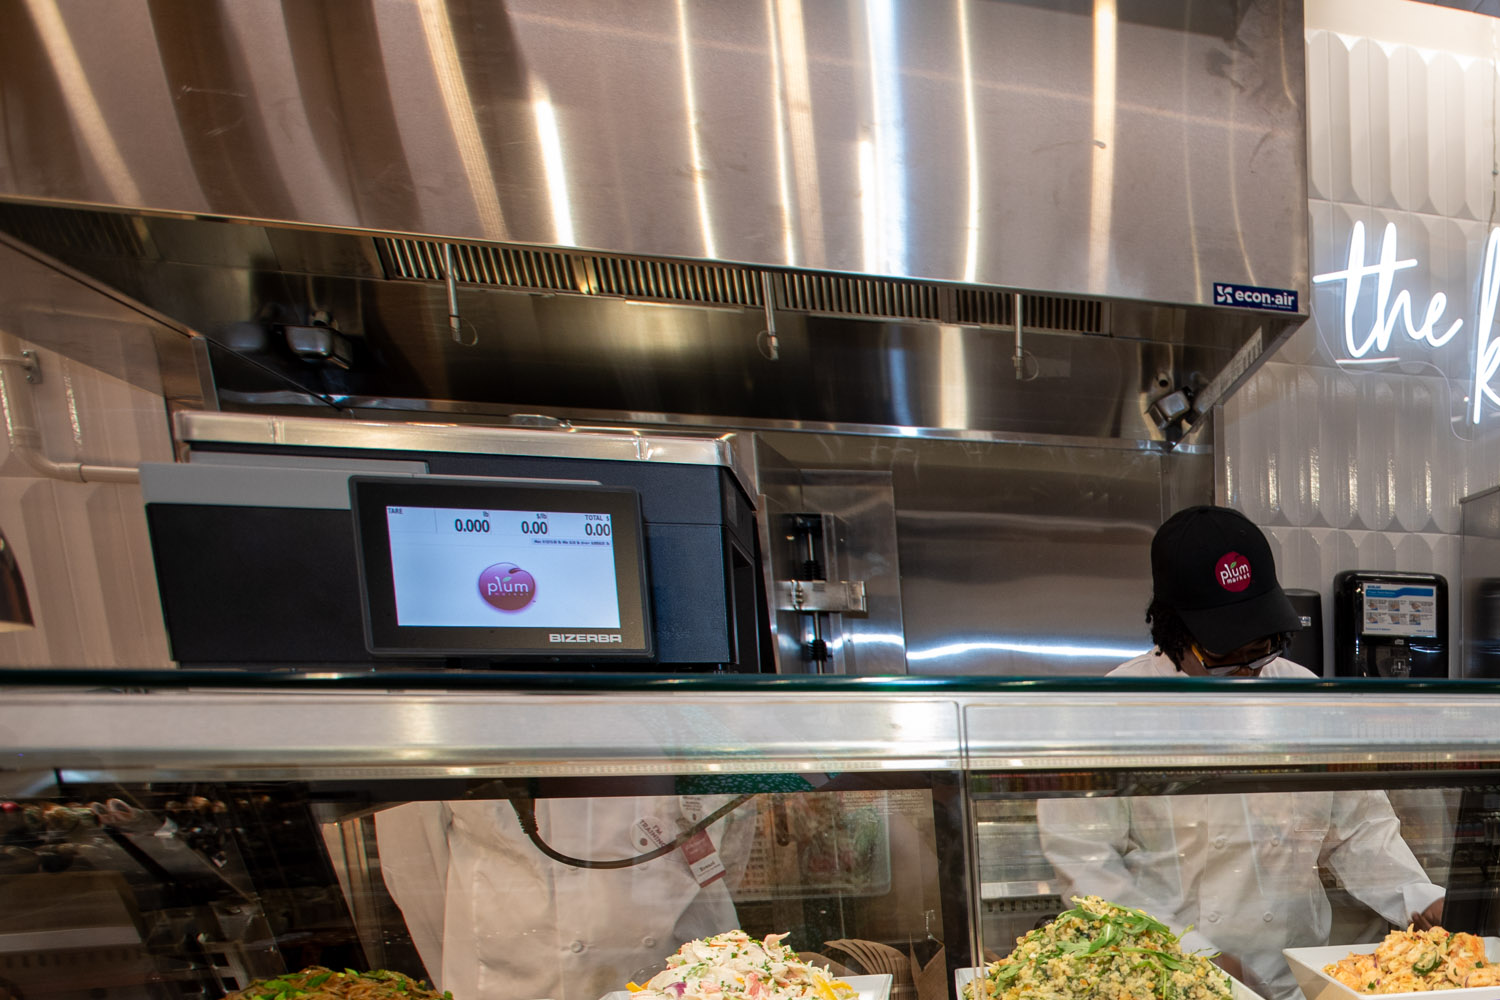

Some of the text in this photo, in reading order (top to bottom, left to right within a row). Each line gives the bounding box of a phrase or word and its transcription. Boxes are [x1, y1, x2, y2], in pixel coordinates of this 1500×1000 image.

[1312, 221, 1463, 359] the
[455, 519, 490, 533] 0.000
[521, 521, 548, 534] 0.00
[585, 523, 610, 536] 0.00
[1220, 564, 1248, 585] plum
[1227, 573, 1250, 584] market
[488, 576, 528, 595] plum
[549, 633, 622, 643] BIZERBA
